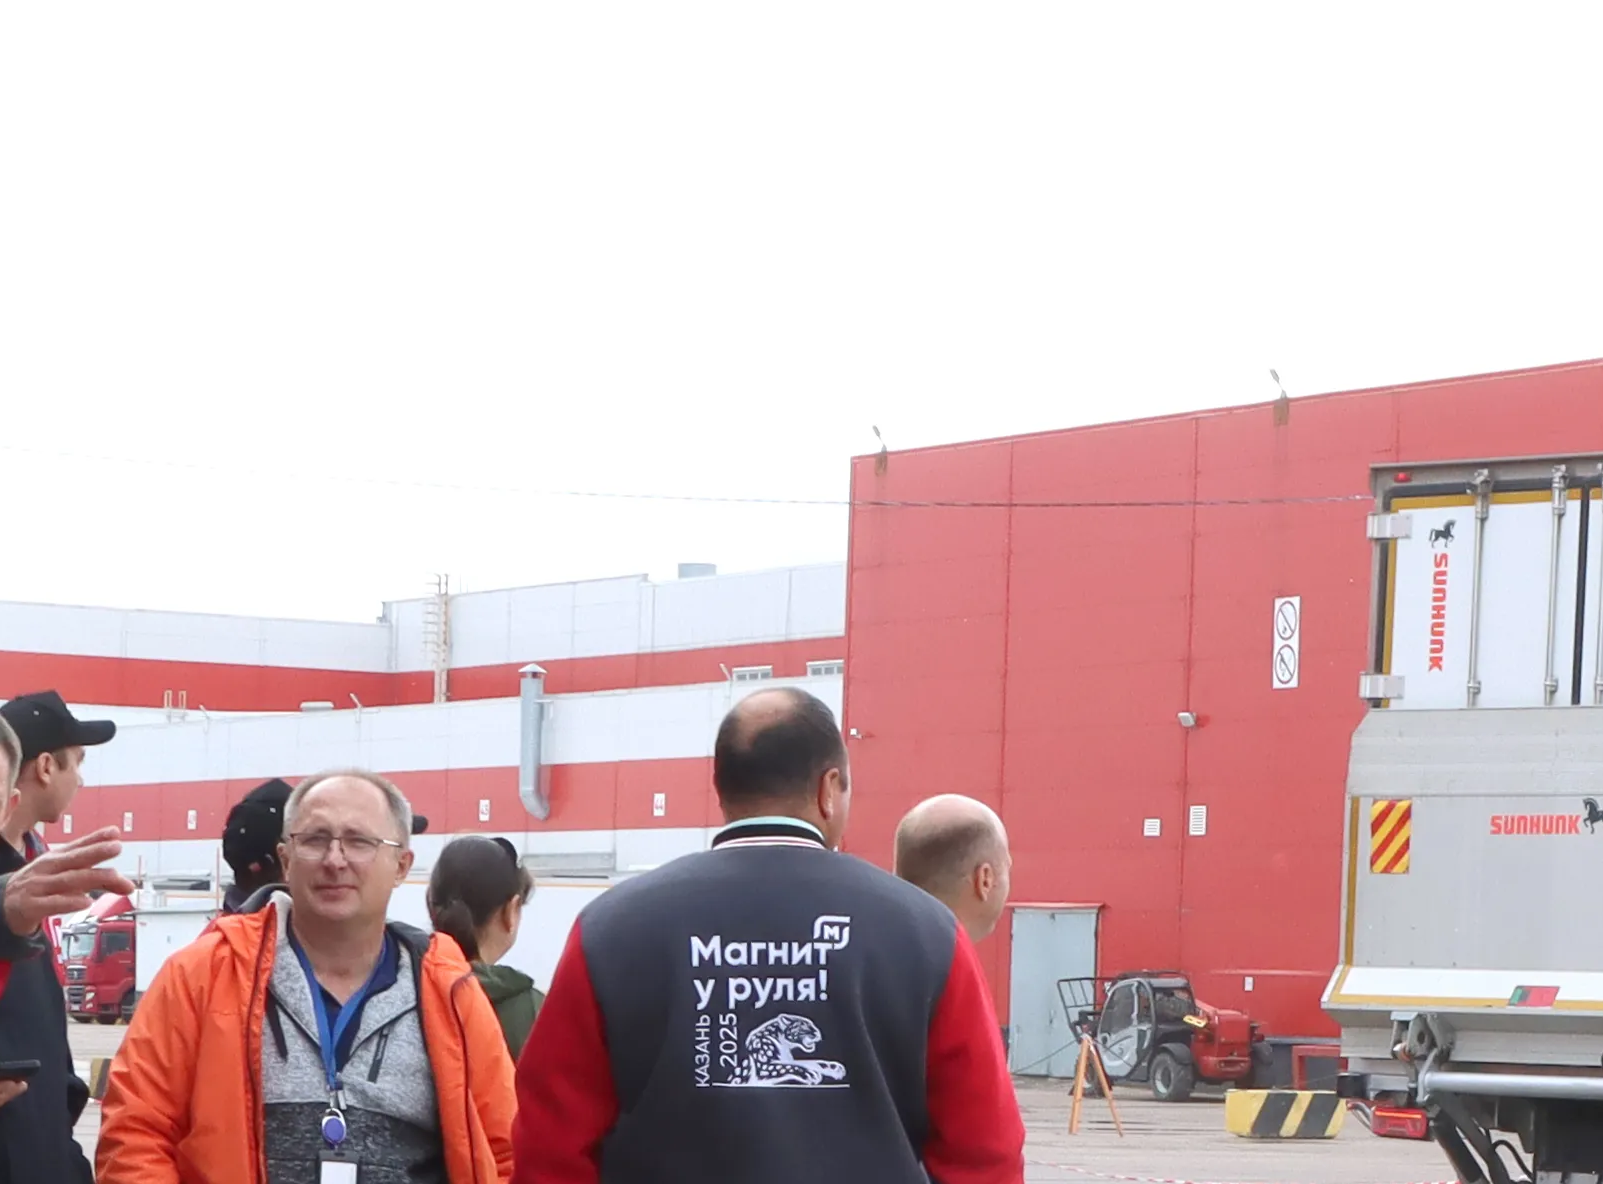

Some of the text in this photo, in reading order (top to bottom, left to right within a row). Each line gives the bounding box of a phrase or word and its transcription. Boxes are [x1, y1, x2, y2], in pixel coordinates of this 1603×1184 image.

[1428, 553, 1448, 672] SUNHUNK
[1490, 814, 1581, 835] SUNHUNK
[690, 935, 833, 967] Магнит
[693, 969, 828, 1010] у руля!
[694, 1014, 711, 1087] КАЗАНЬ
[719, 1012, 737, 1067] 2025
